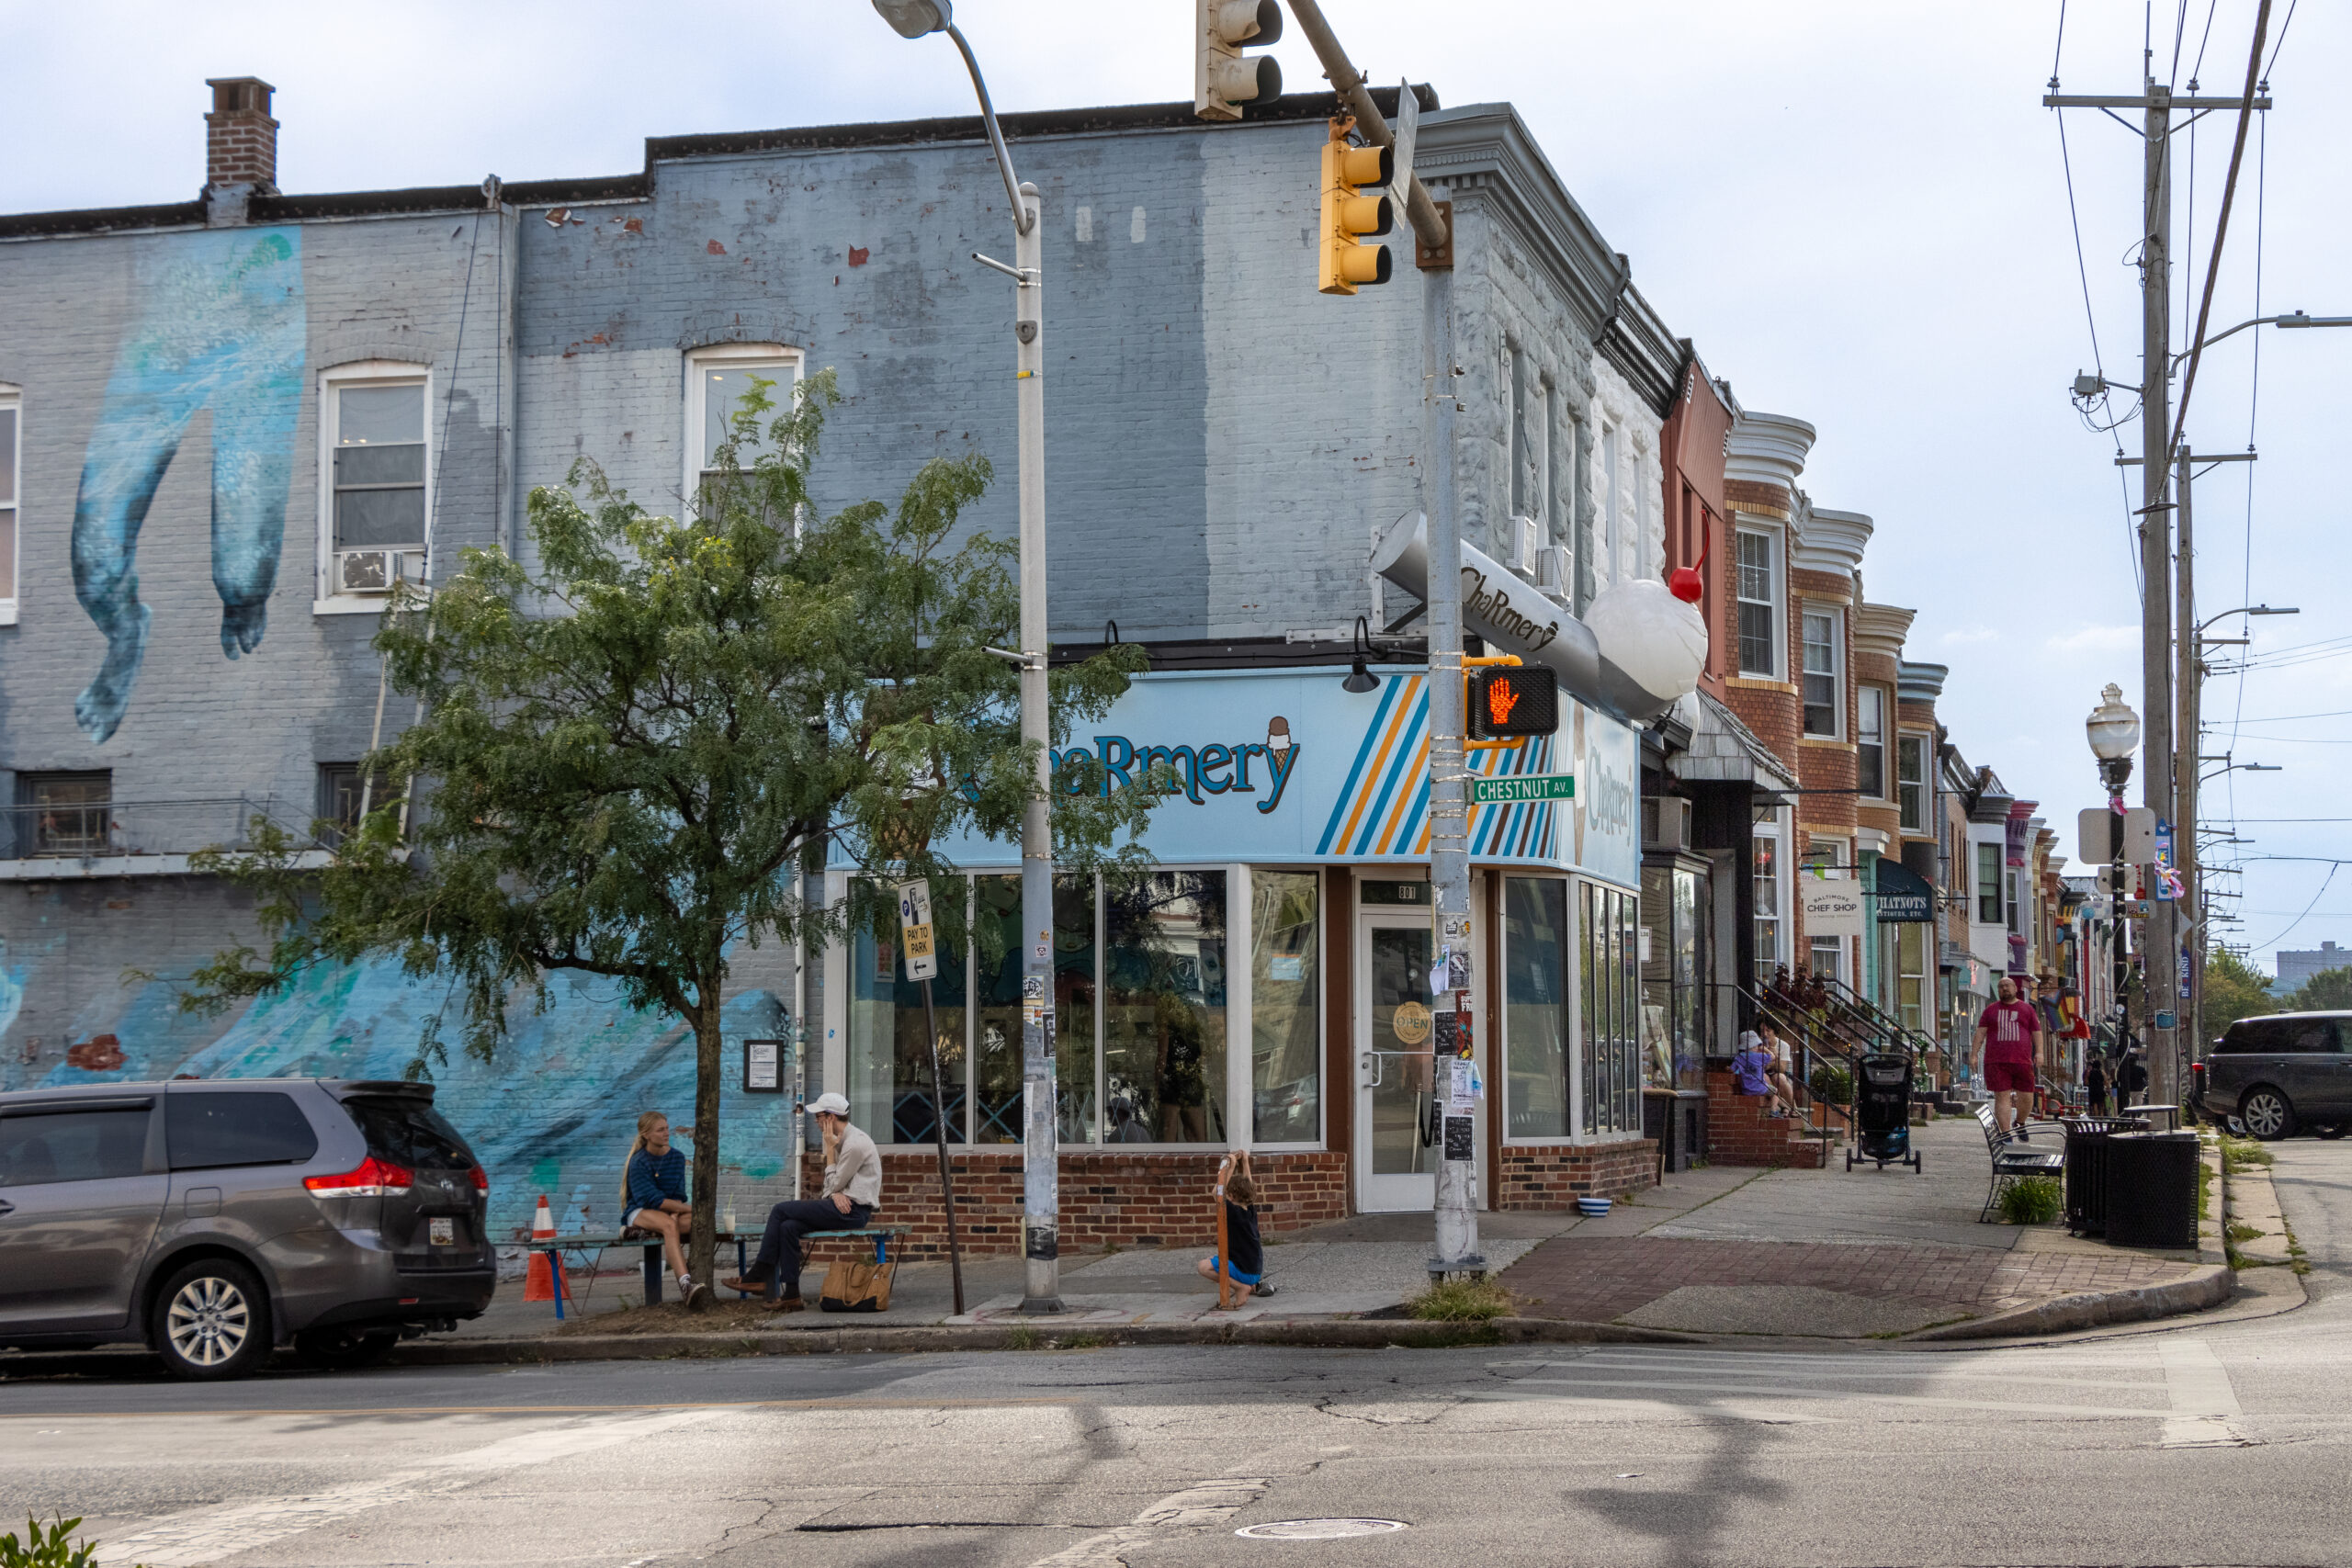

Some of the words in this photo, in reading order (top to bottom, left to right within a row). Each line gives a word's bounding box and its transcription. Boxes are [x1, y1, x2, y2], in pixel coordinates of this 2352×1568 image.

[1477, 779, 1550, 800] CHESTNUT
[1554, 781, 1568, 793] AV.
[1399, 886, 1415, 898] 801
[1814, 895, 1849, 903] BALTIMORE
[1807, 904, 1830, 912] CHEF
[1833, 903, 1857, 911] SHOP
[908, 929, 919, 941] PAY
[920, 927, 928, 938] TO
[910, 942, 928, 954] PARK
[2182, 986, 2189, 997] BE
[1396, 1016, 1429, 1029] OPEN
